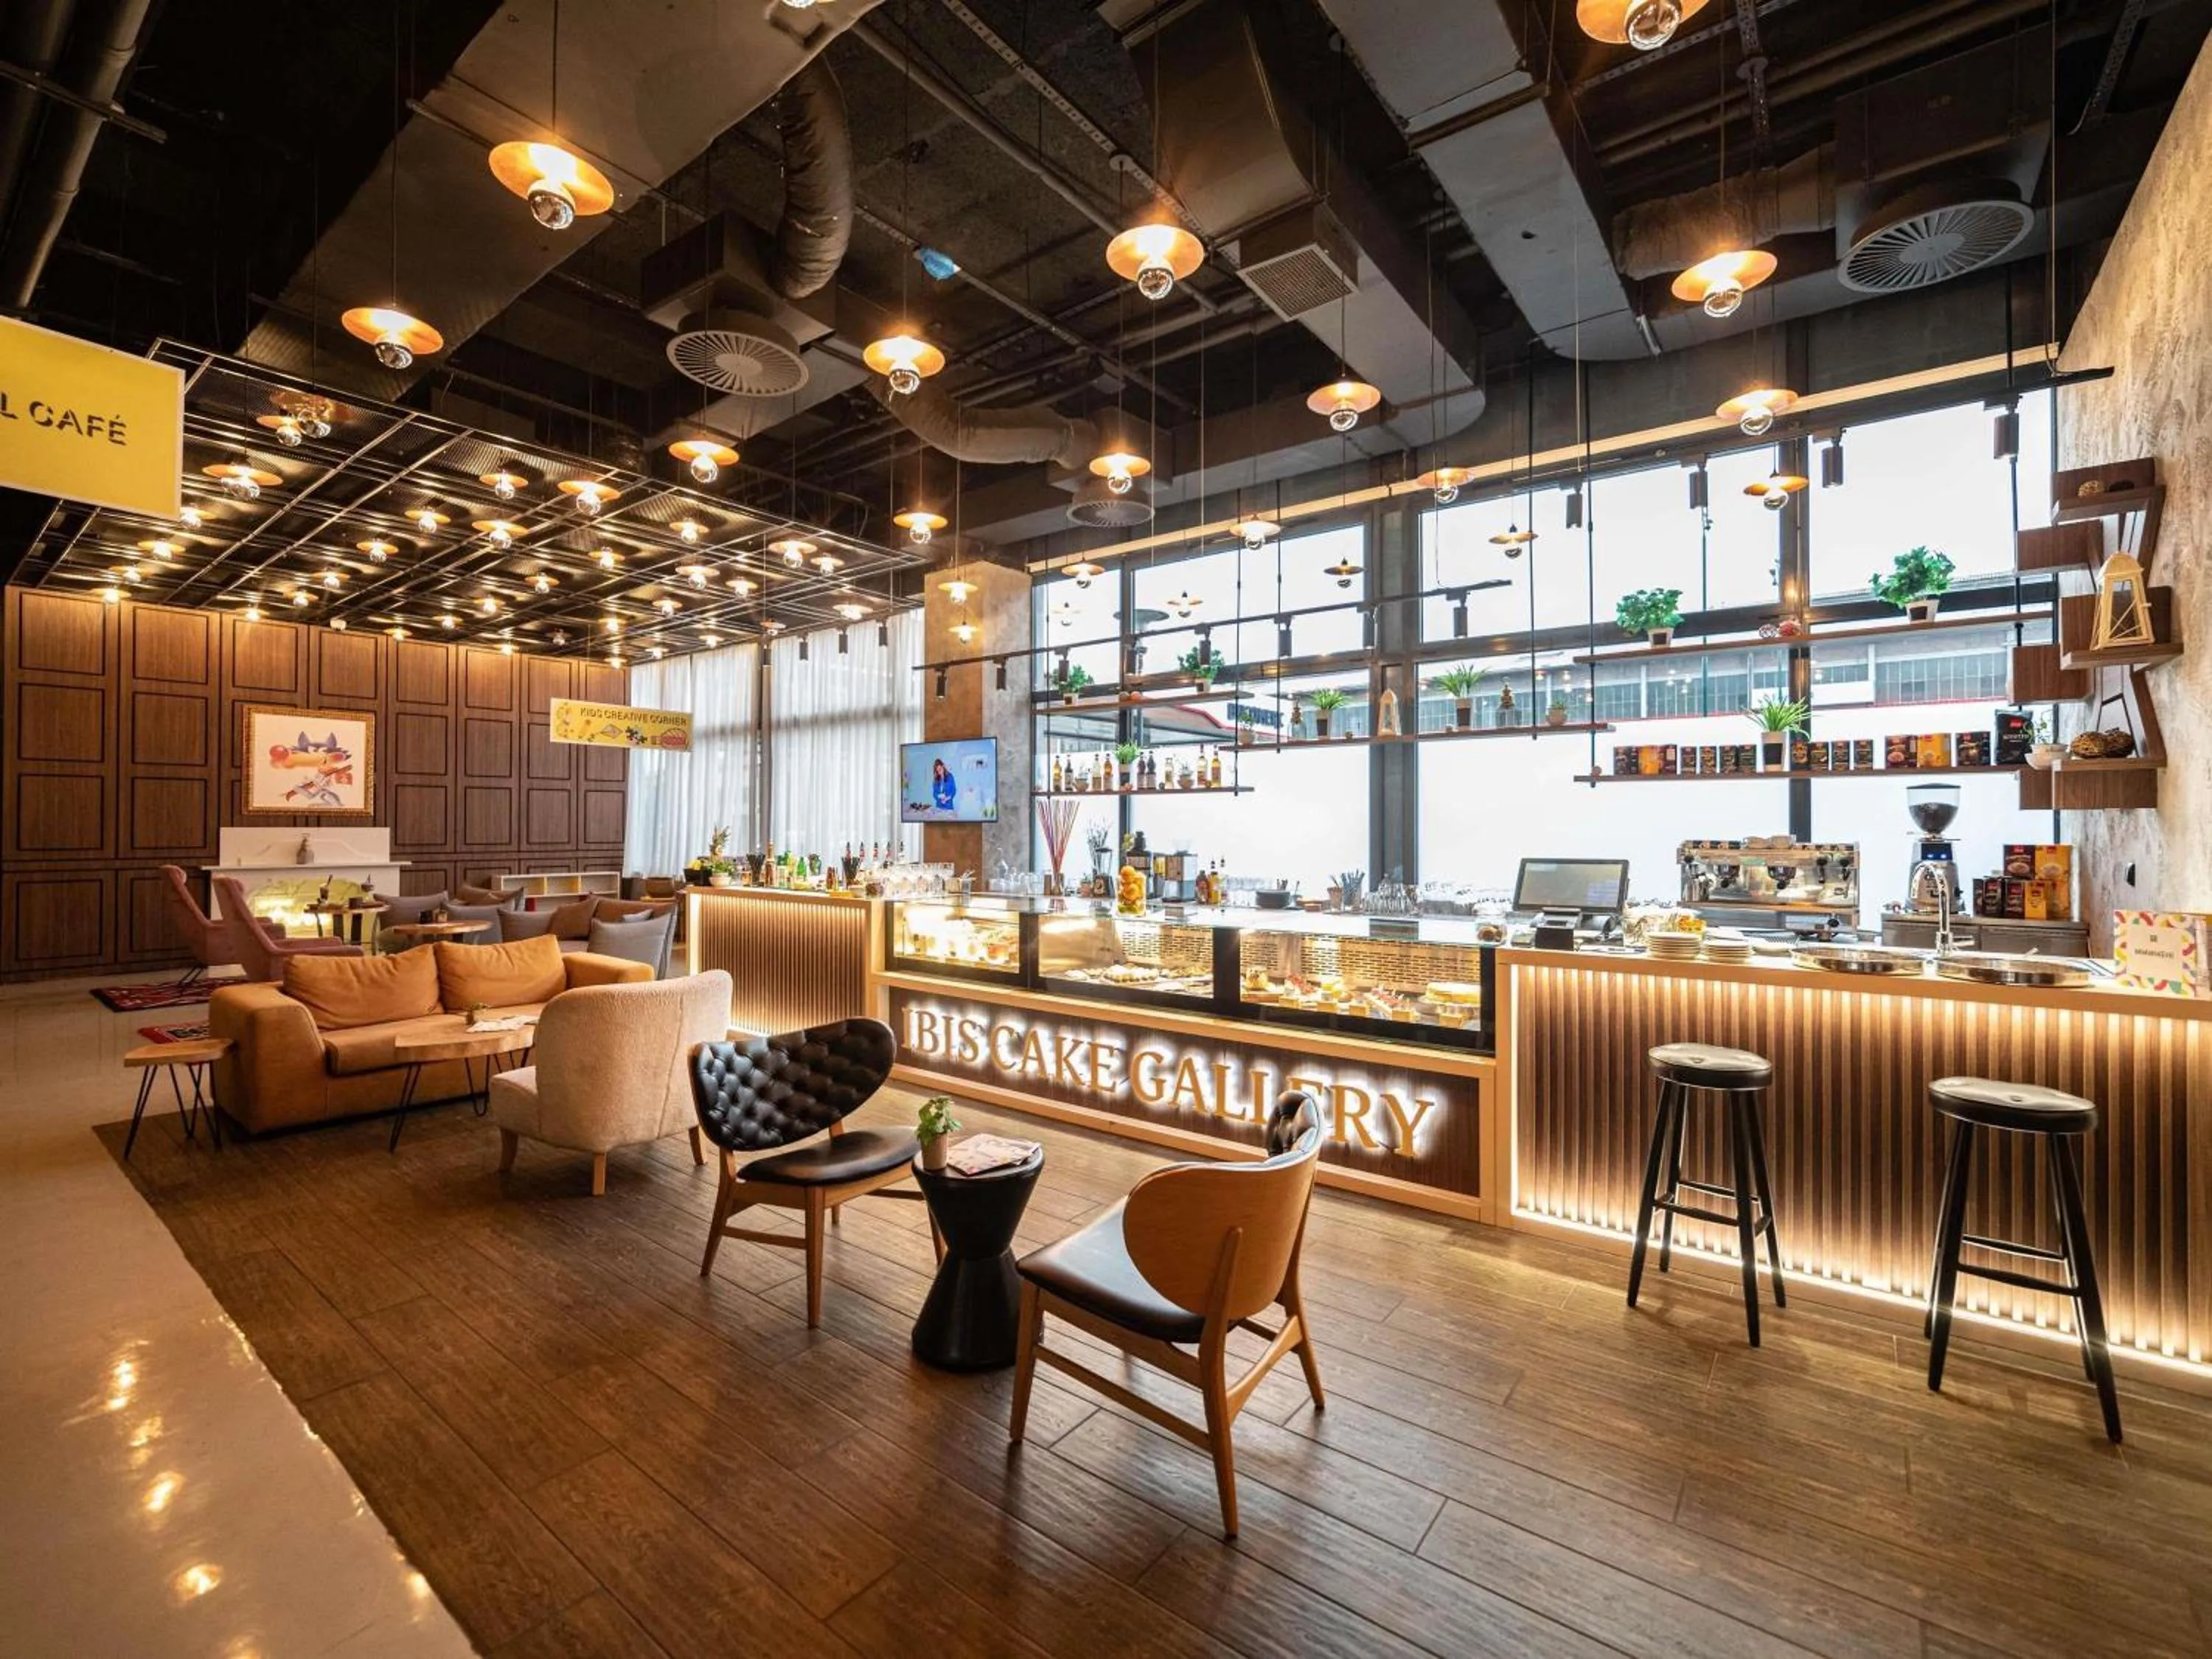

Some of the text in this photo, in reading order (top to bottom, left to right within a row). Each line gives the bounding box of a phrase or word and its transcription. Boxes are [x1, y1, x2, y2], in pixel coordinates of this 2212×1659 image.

[29, 400, 127, 446] CAFÉ
[604, 710, 647, 723] CREATIVE
[901, 1006, 986, 1063] IBIS
[990, 1025, 1122, 1094] CAKE
